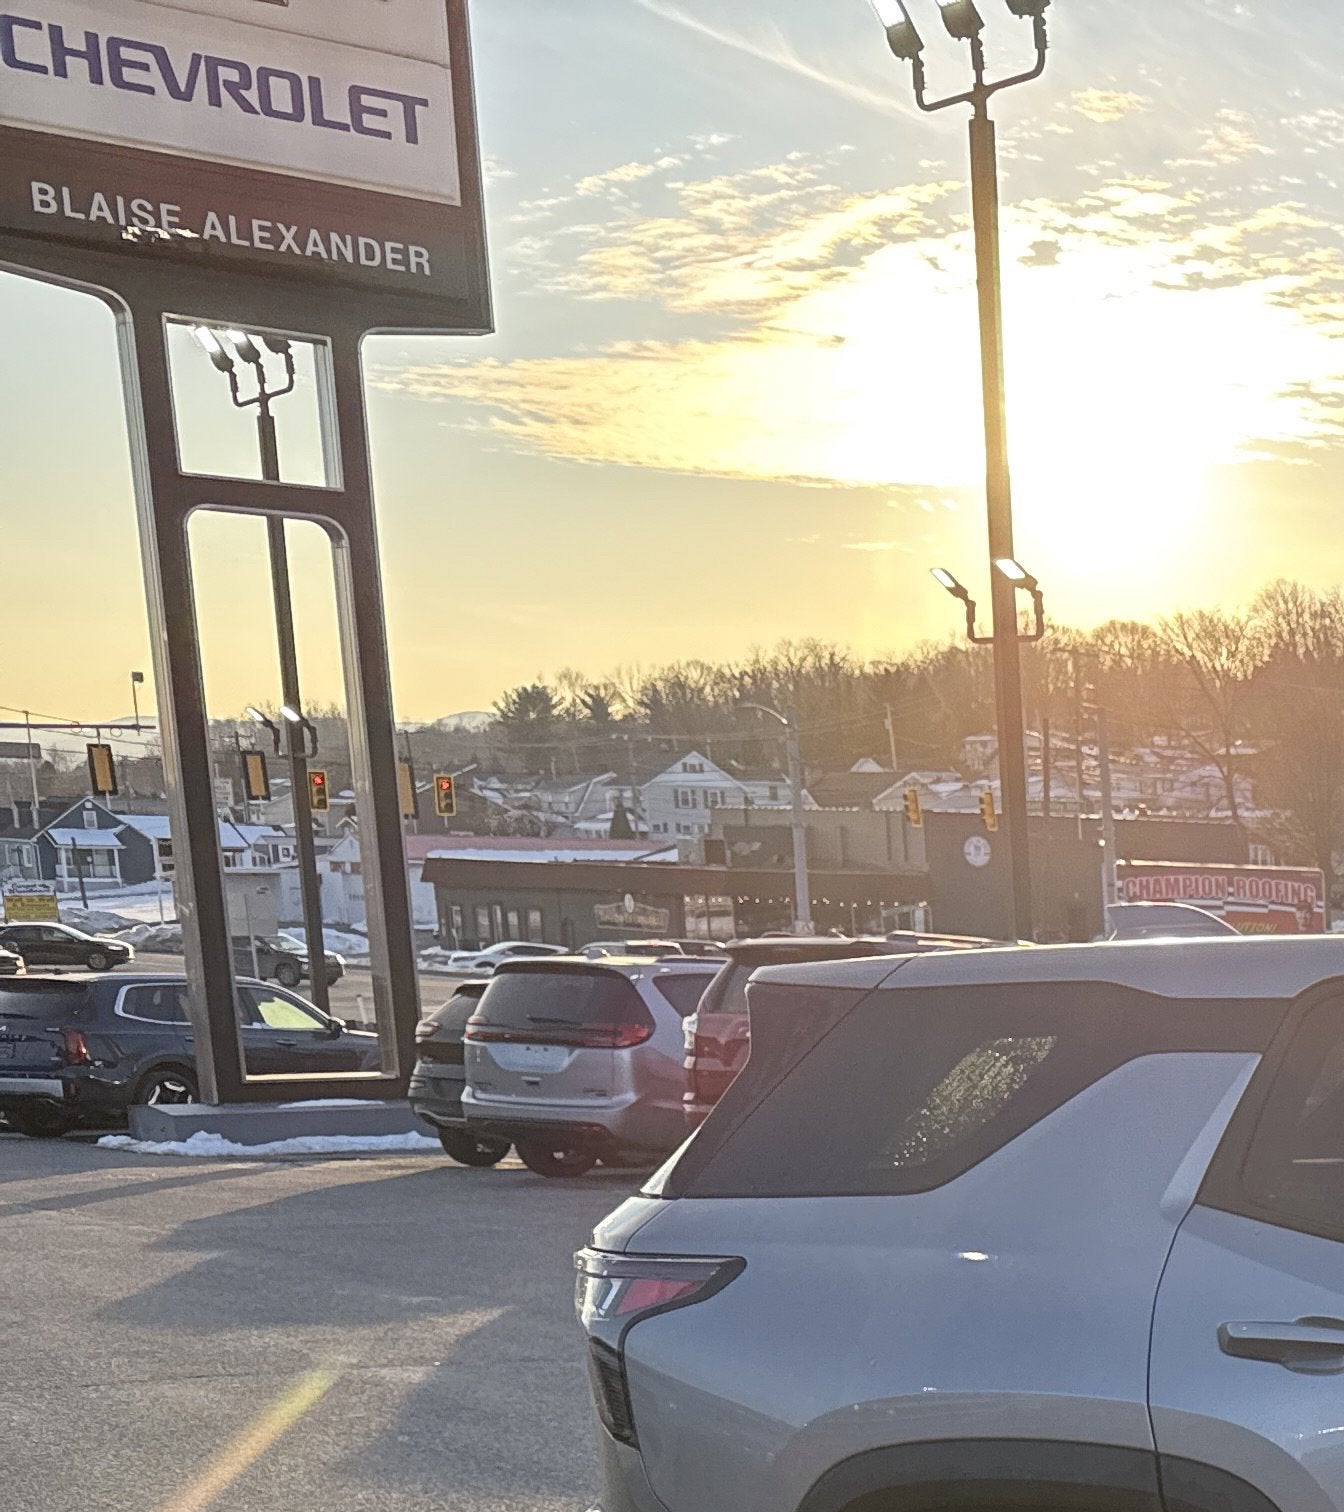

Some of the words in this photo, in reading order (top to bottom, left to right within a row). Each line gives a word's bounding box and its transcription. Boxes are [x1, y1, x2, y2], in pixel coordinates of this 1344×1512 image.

[0, 13, 428, 145] CHEVROLET
[31, 180, 182, 233] BLAISE
[202, 211, 431, 275] ALEXANDER
[1123, 874, 1228, 900] CHAMPION
[1233, 876, 1316, 904] ROOFING
